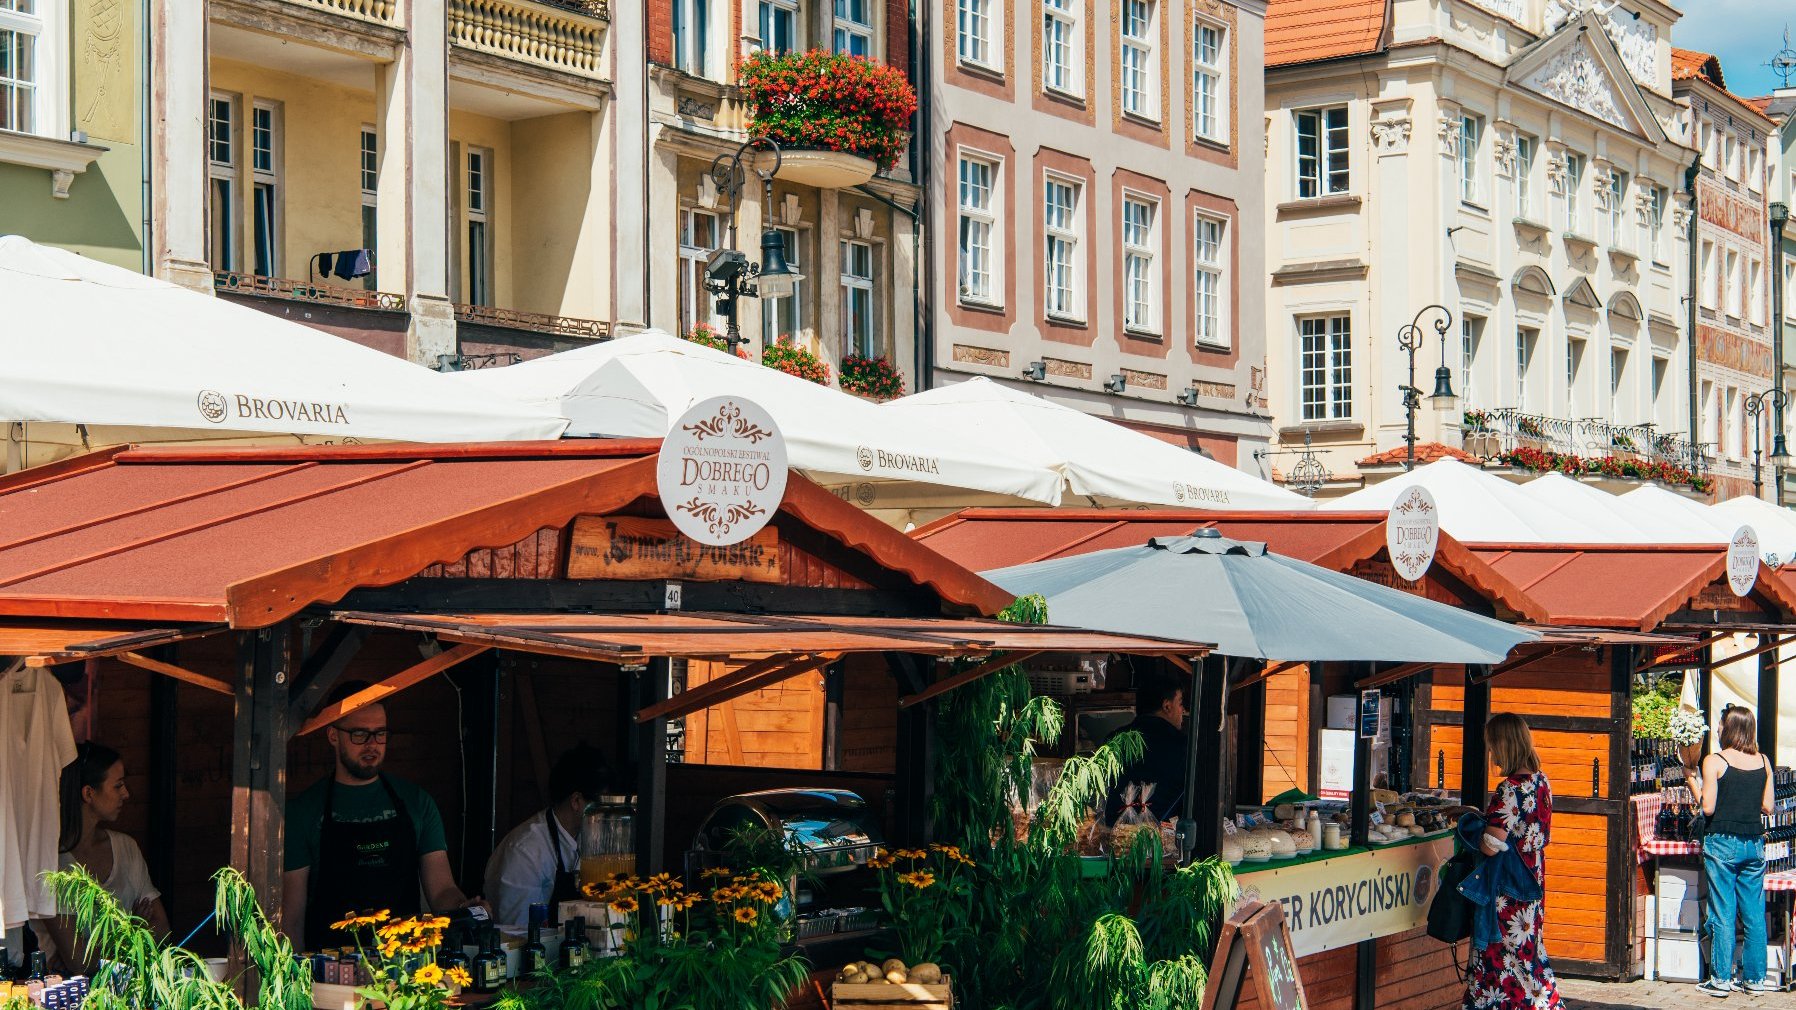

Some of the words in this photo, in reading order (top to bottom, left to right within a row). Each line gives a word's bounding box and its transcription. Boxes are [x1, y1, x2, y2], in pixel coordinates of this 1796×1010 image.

[234, 394, 350, 425] BROVARIA
[680, 458, 770, 491] DOBREGO
[877, 449, 939, 475] BROVARIA
[697, 483, 752, 497] SMAKU
[1186, 484, 1231, 504] BROVARIA
[667, 590, 679, 603] 40
[1309, 868, 1411, 928] KORYCIŃSKI
